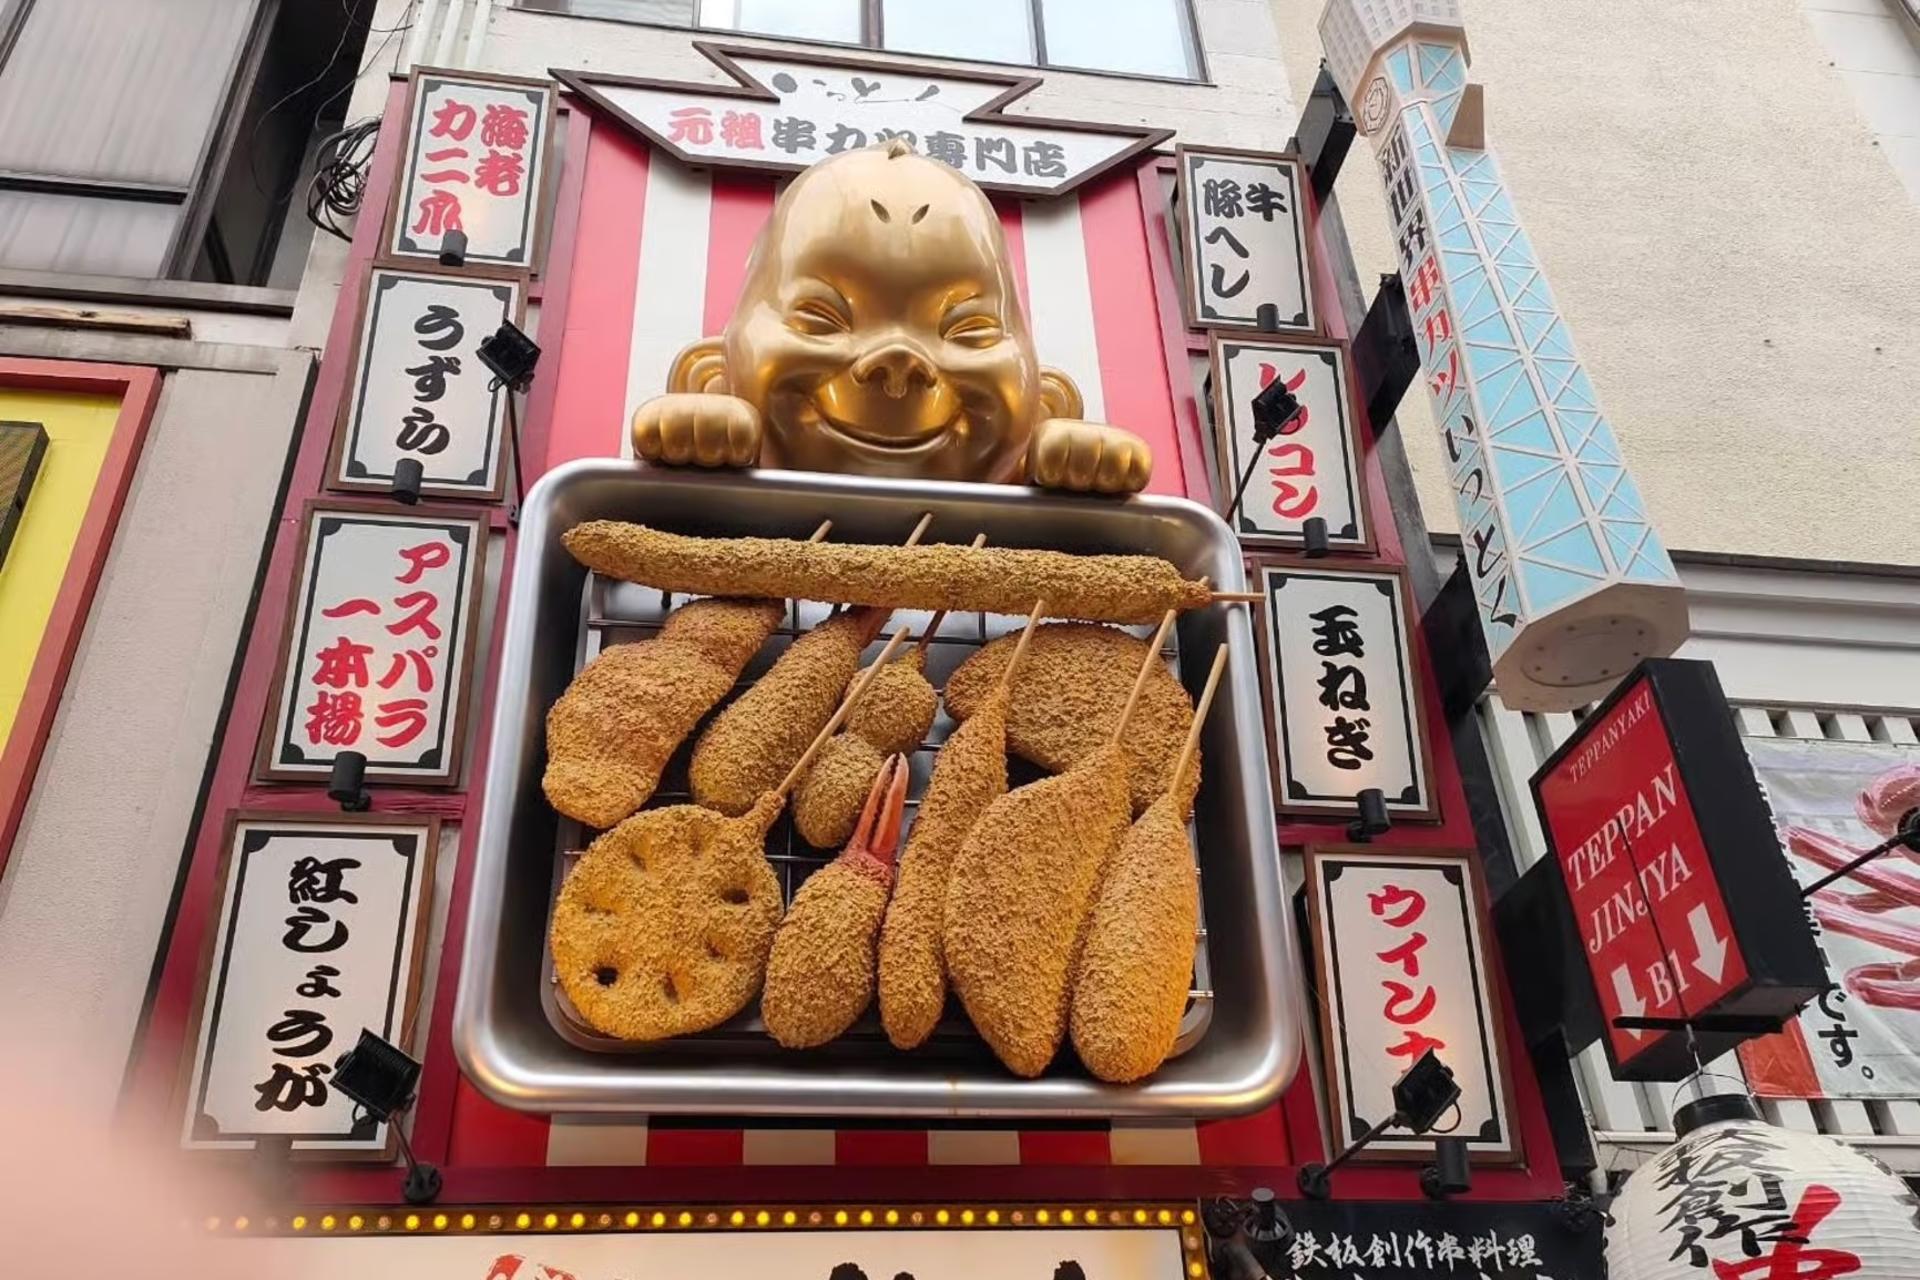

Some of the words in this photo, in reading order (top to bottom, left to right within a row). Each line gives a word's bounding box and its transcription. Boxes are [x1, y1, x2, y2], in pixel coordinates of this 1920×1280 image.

[474, 104, 529, 196] 海老
[1244, 182, 1288, 222] 牛
[396, 304, 465, 456] うずら
[305, 598, 382, 746] 一本揚
[374, 541, 451, 748] アスパラ
[1308, 604, 1374, 770] 玉ねぎ
[1569, 690, 1652, 785] TEPPANYAKI
[1566, 763, 1679, 893] TEPPAN
[1588, 841, 1693, 955] JINJYA
[254, 856, 362, 1112] 紅しょうが
[1645, 951, 1691, 1010] B1
[1285, 1229, 1544, 1272] 鉄板創作串料理
